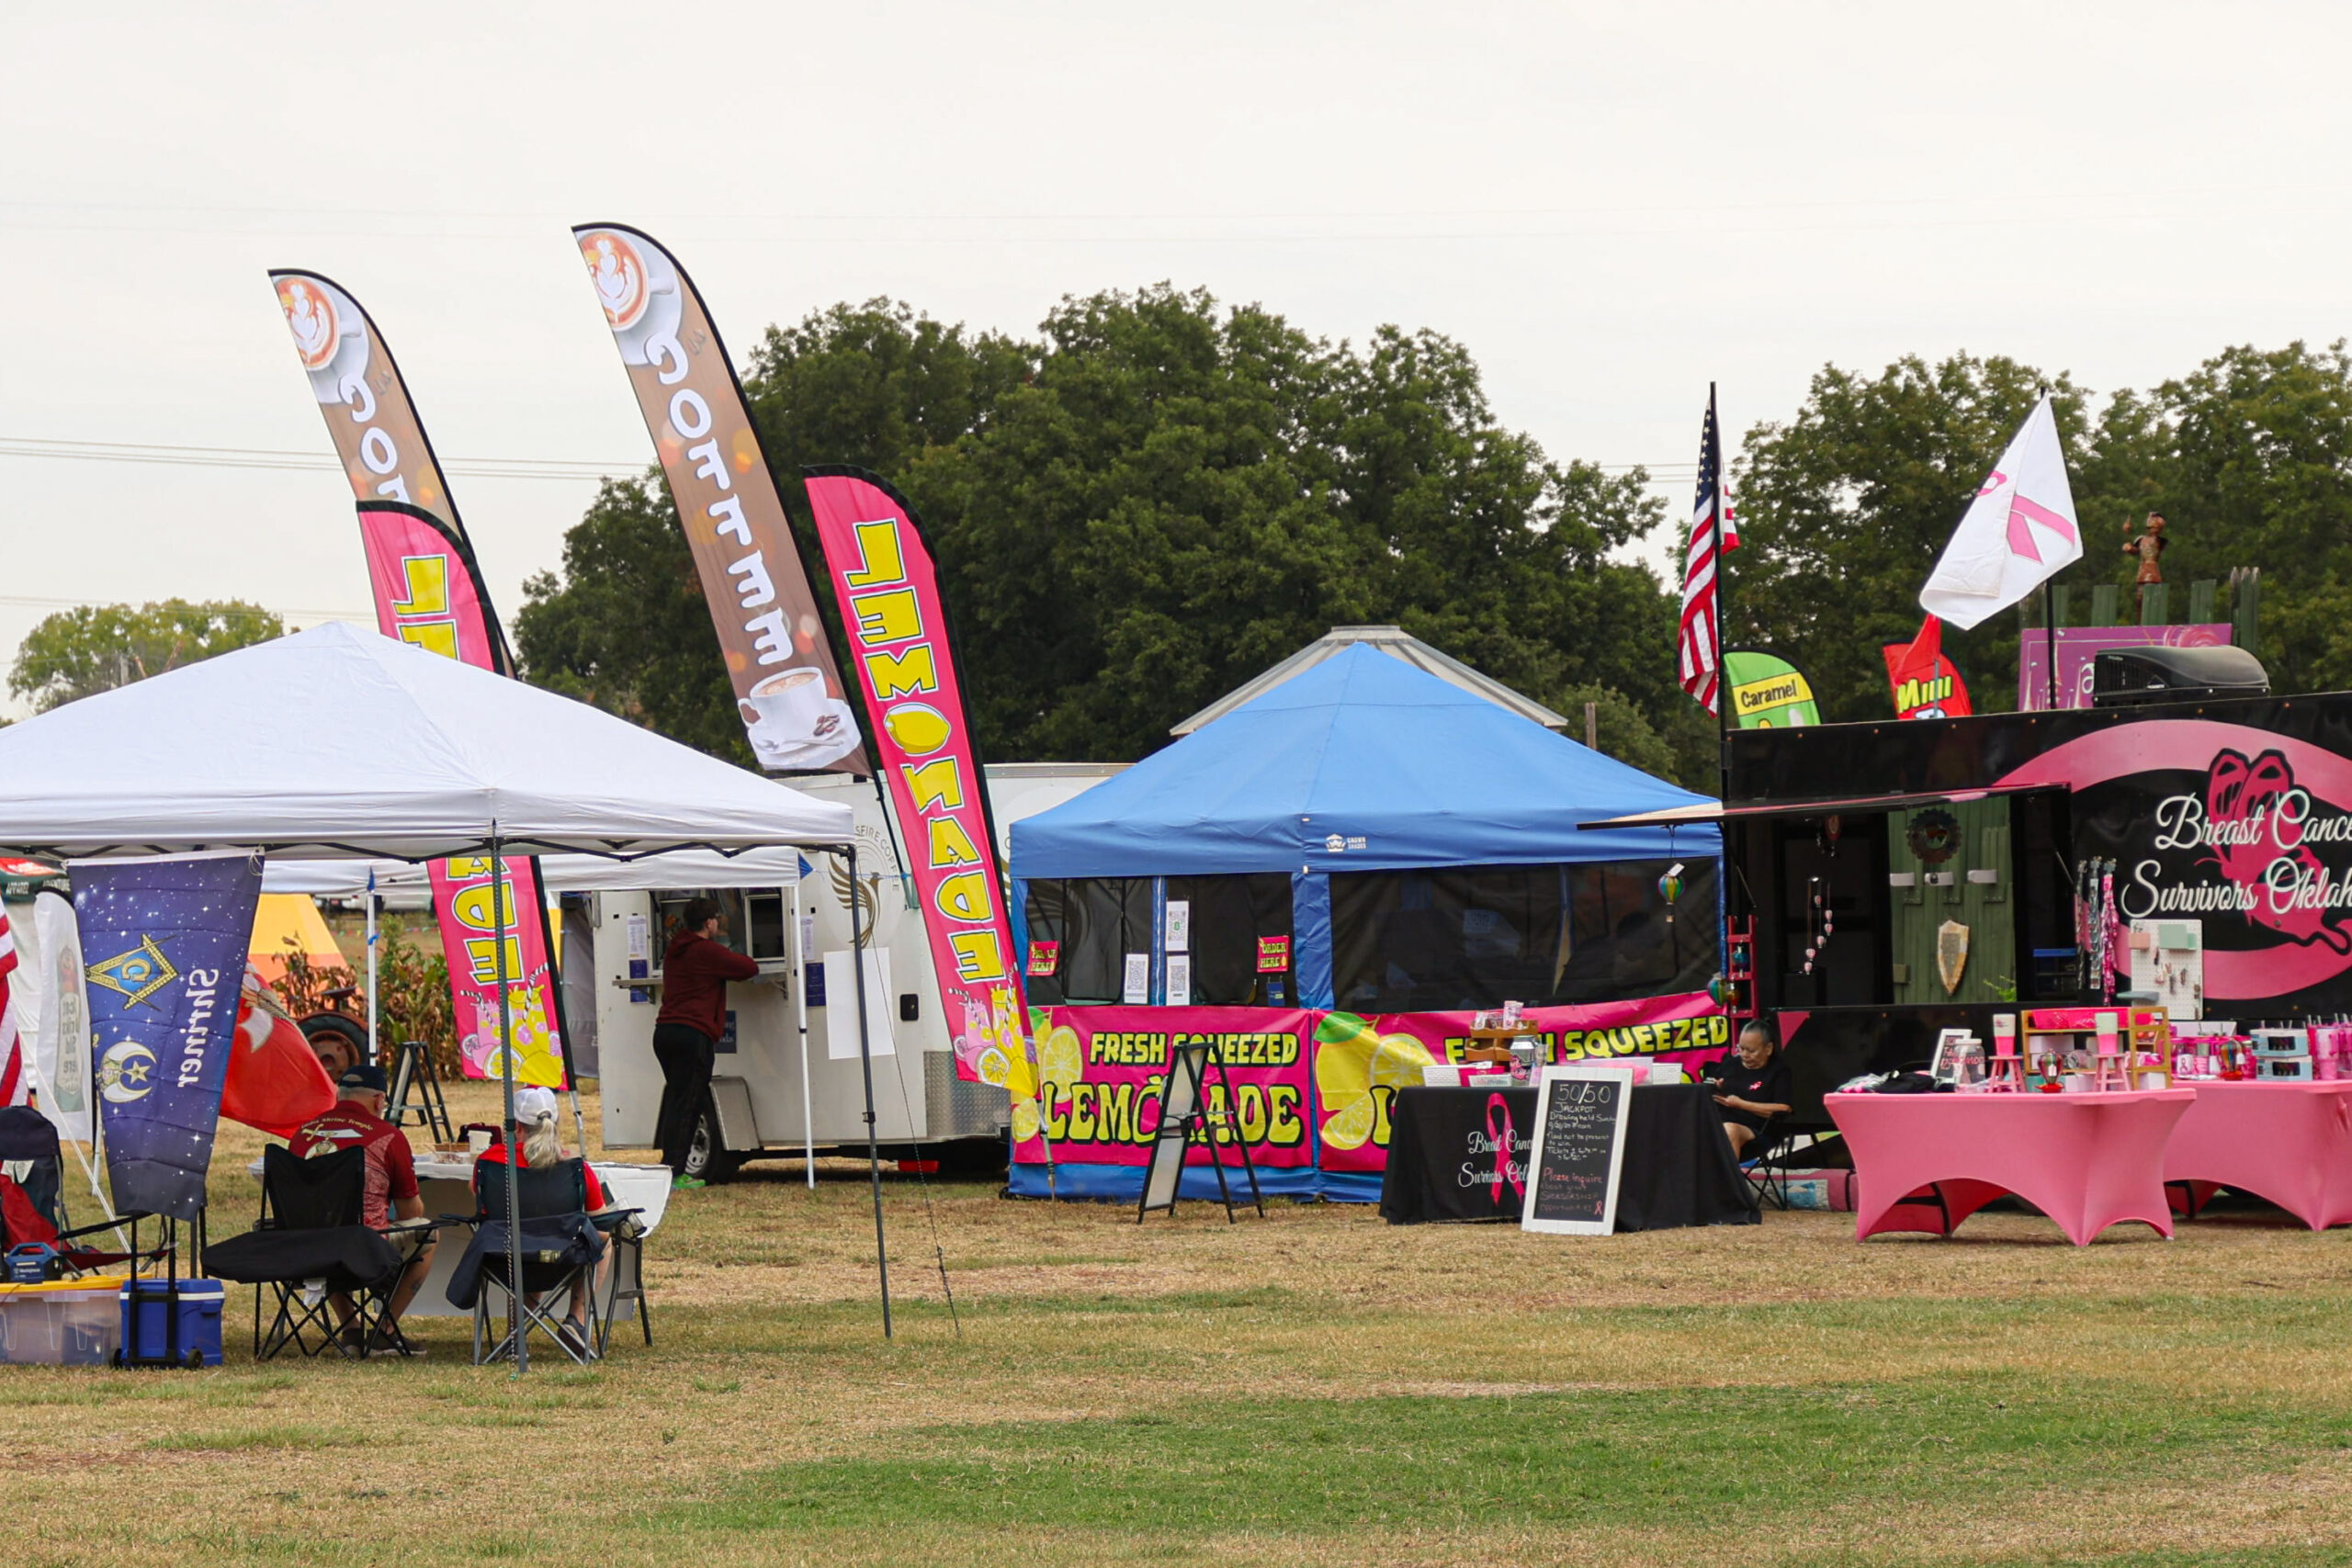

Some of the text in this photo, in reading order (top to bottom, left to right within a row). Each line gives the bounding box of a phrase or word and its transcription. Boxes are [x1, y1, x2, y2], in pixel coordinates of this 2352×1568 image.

[1740, 679, 1798, 708] Caramel
[2154, 792, 2266, 850] Breast
[2121, 859, 2258, 919] Survivors
[1260, 957, 1280, 968] HERE
[1262, 942, 1287, 954] ORDER
[1089, 1032, 1168, 1065] FRESH
[1564, 1015, 1729, 1061] SQUEEZED
[1558, 1082, 1611, 1104] 50/50
[1043, 1077, 1305, 1147] LEMOADE
